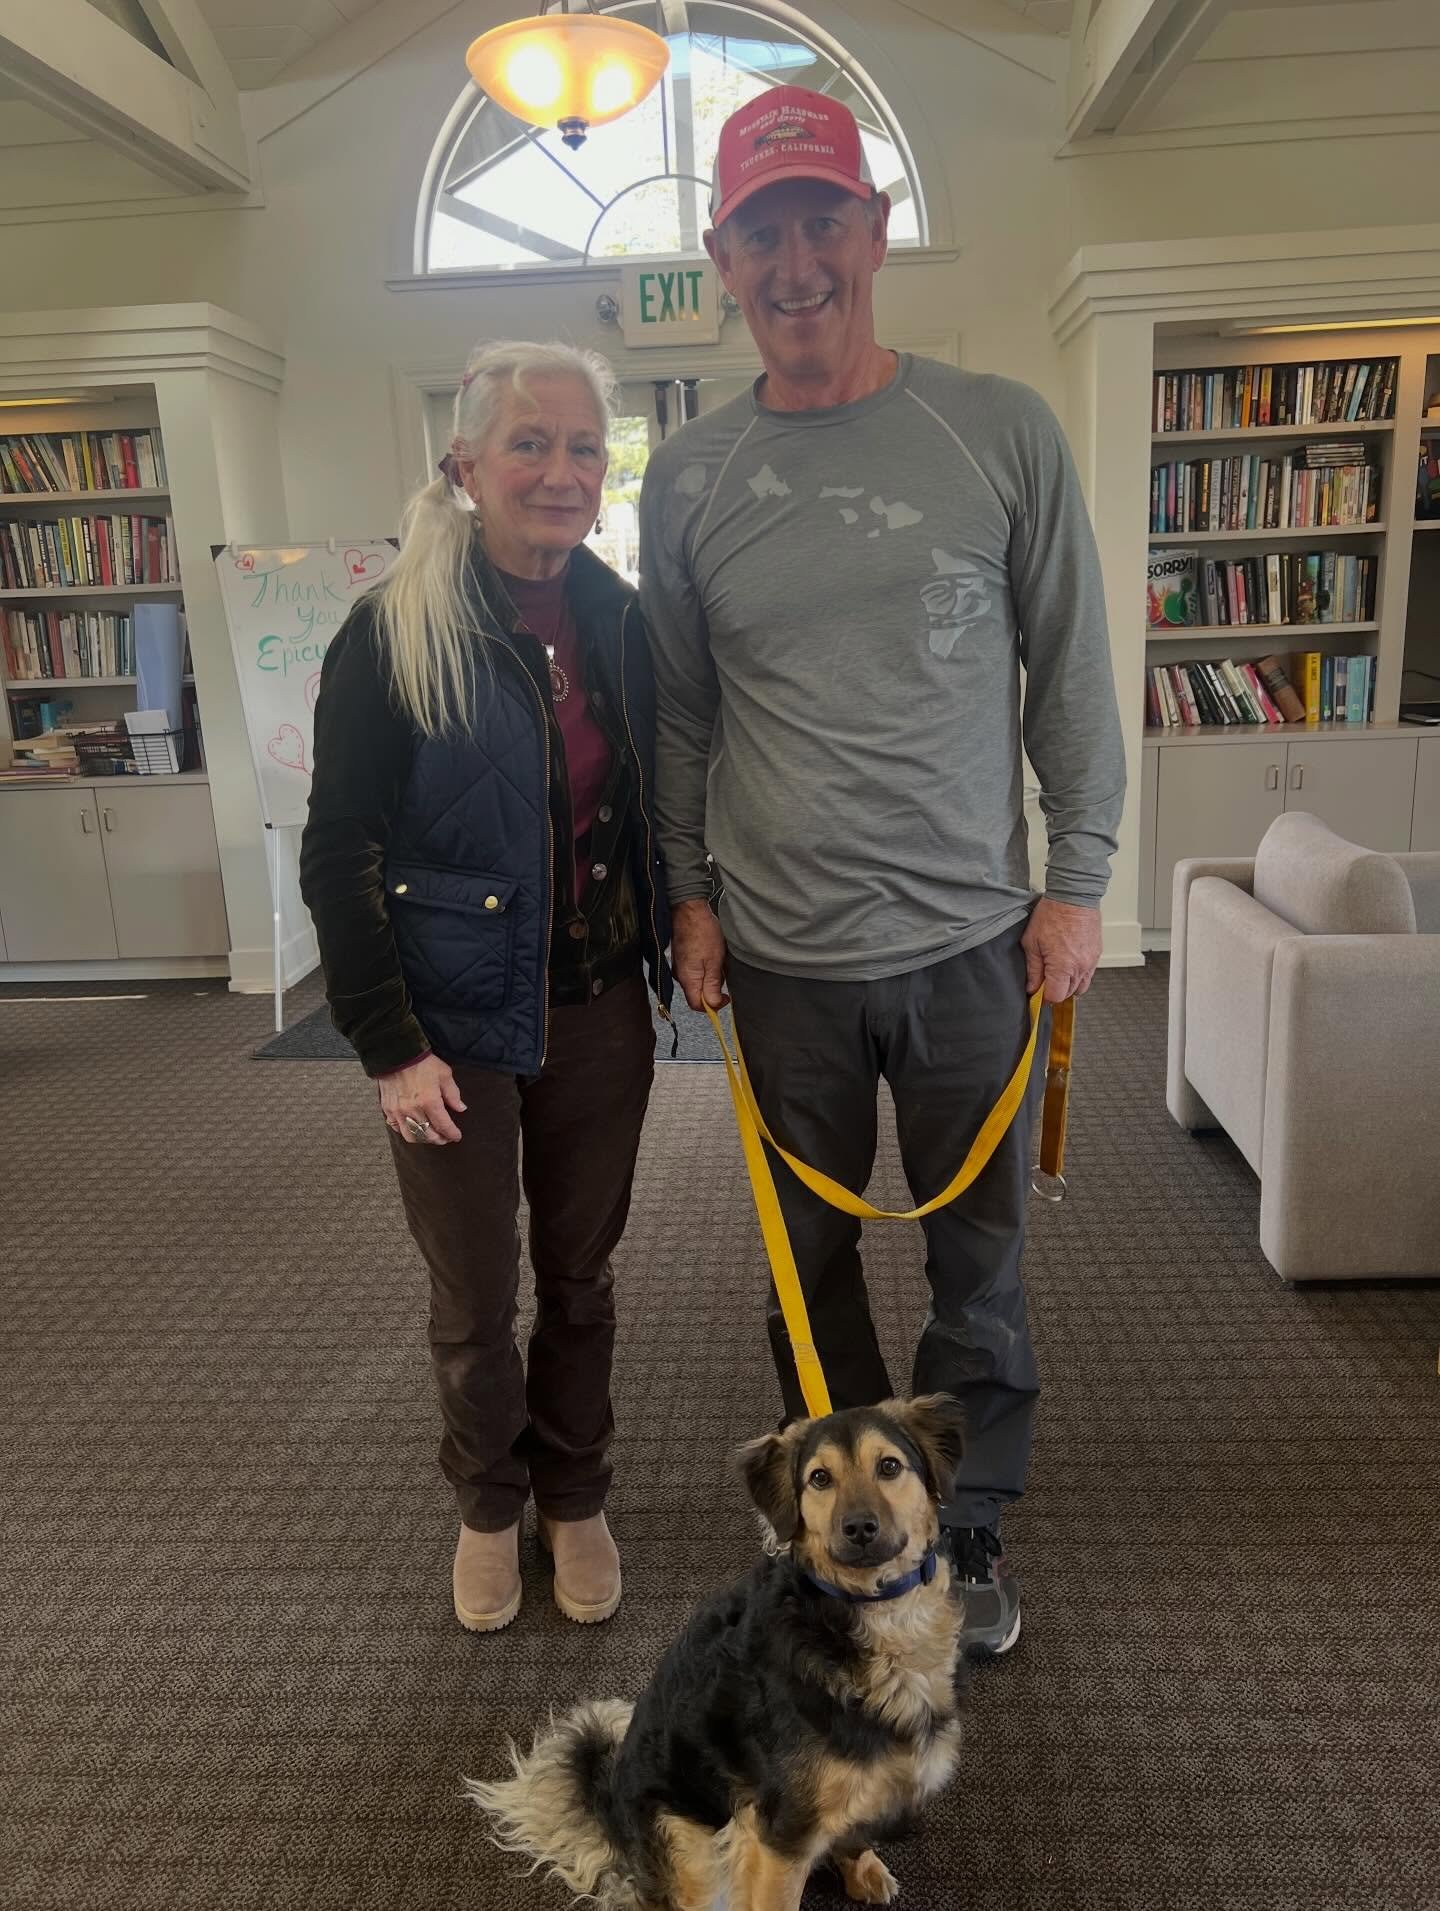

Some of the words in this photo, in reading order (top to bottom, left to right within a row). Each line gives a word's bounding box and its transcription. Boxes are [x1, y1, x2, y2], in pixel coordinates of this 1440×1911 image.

[781, 144, 836, 155] CALIFORNIA
[640, 271, 703, 323] EXIT
[1147, 556, 1193, 579] SORRY!
[243, 565, 346, 608] Thank
